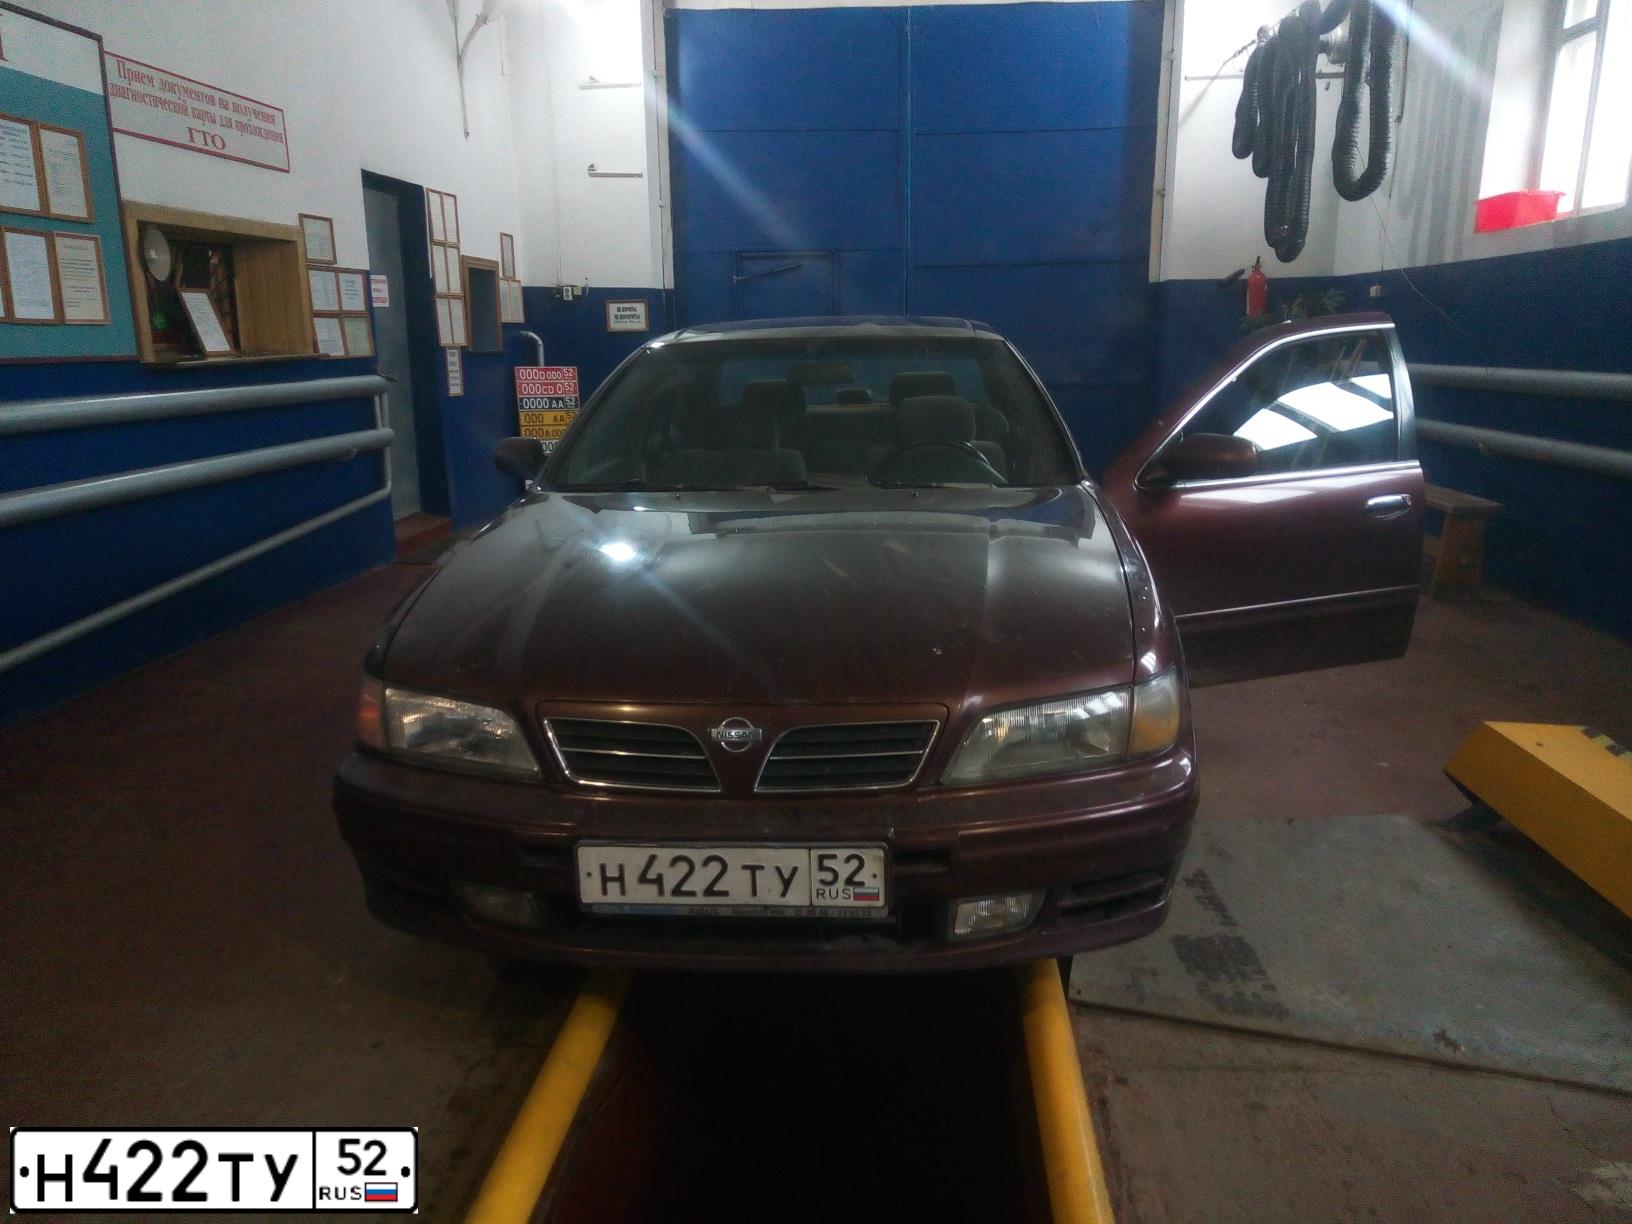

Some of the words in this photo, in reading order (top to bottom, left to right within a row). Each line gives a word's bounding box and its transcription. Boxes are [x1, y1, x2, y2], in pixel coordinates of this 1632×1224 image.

[116, 59, 155, 88] Прием
[159, 77, 216, 106] документов
[218, 97, 230, 111] на
[187, 126, 226, 150] ГТО
[191, 105, 216, 126] карты
[219, 114, 233, 129] для
[235, 119, 283, 144] прохождения
[715, 729, 759, 741] NISSAN
[816, 853, 866, 888] 52
[815, 887, 852, 901] RUS
